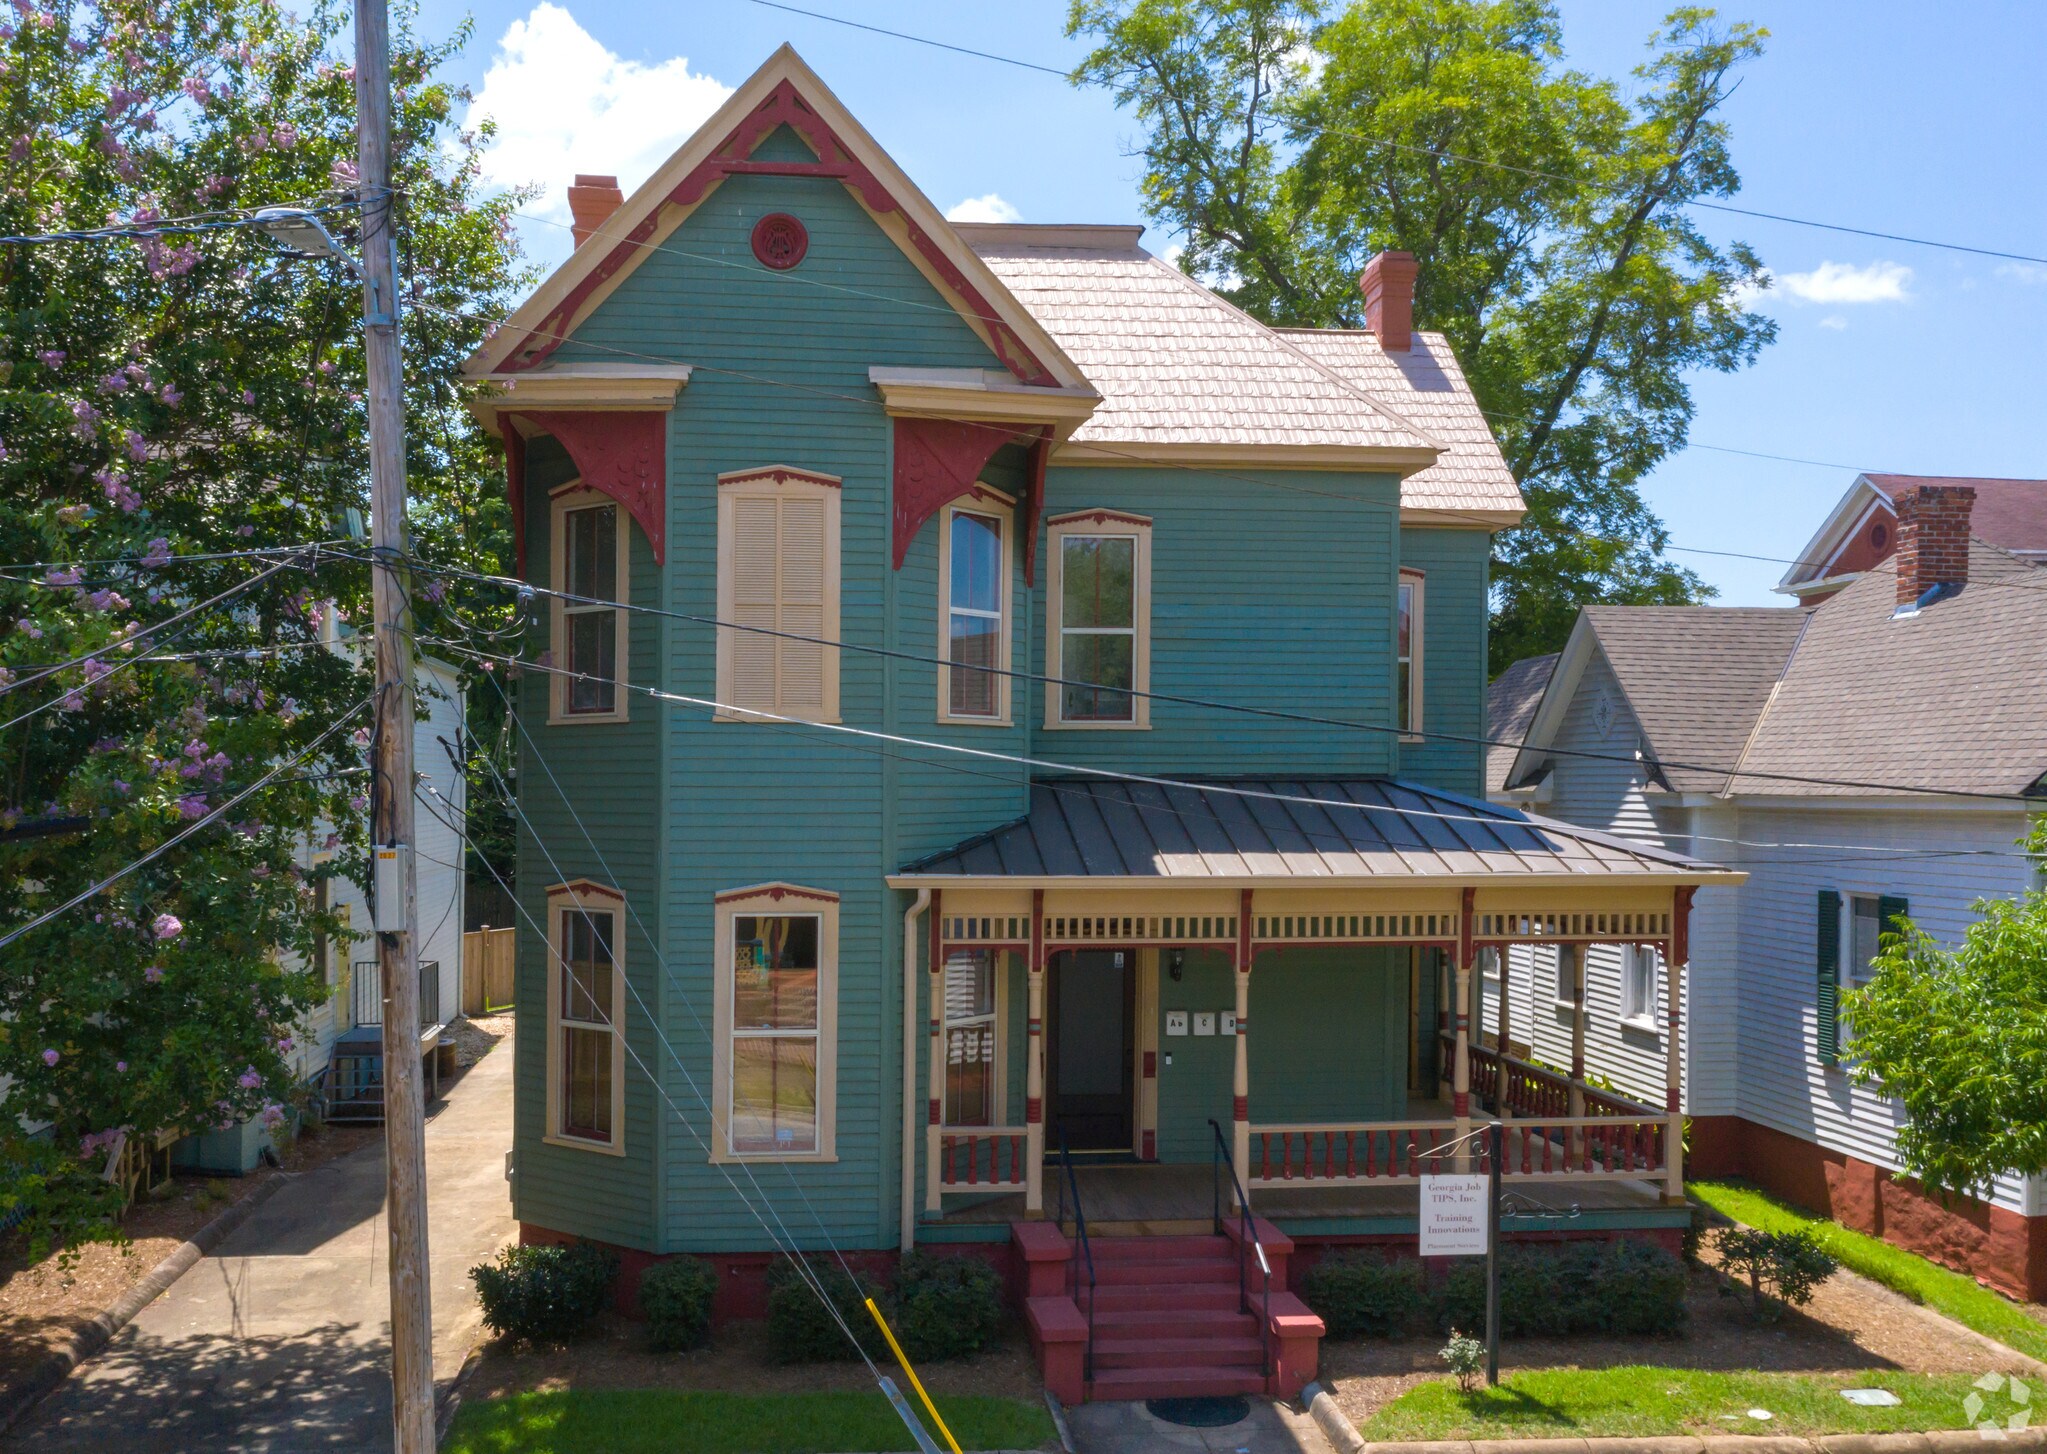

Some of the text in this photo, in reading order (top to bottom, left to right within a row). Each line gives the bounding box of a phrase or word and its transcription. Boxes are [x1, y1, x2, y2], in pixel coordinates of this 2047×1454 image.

[1202, 1019, 1207, 1027] C
[1428, 1183, 1481, 1193] Georgia Job
[1432, 1194, 1477, 1203] TIPS, Inc.
[1434, 1214, 1473, 1223] Training
[1428, 1226, 1480, 1234] Innovations
